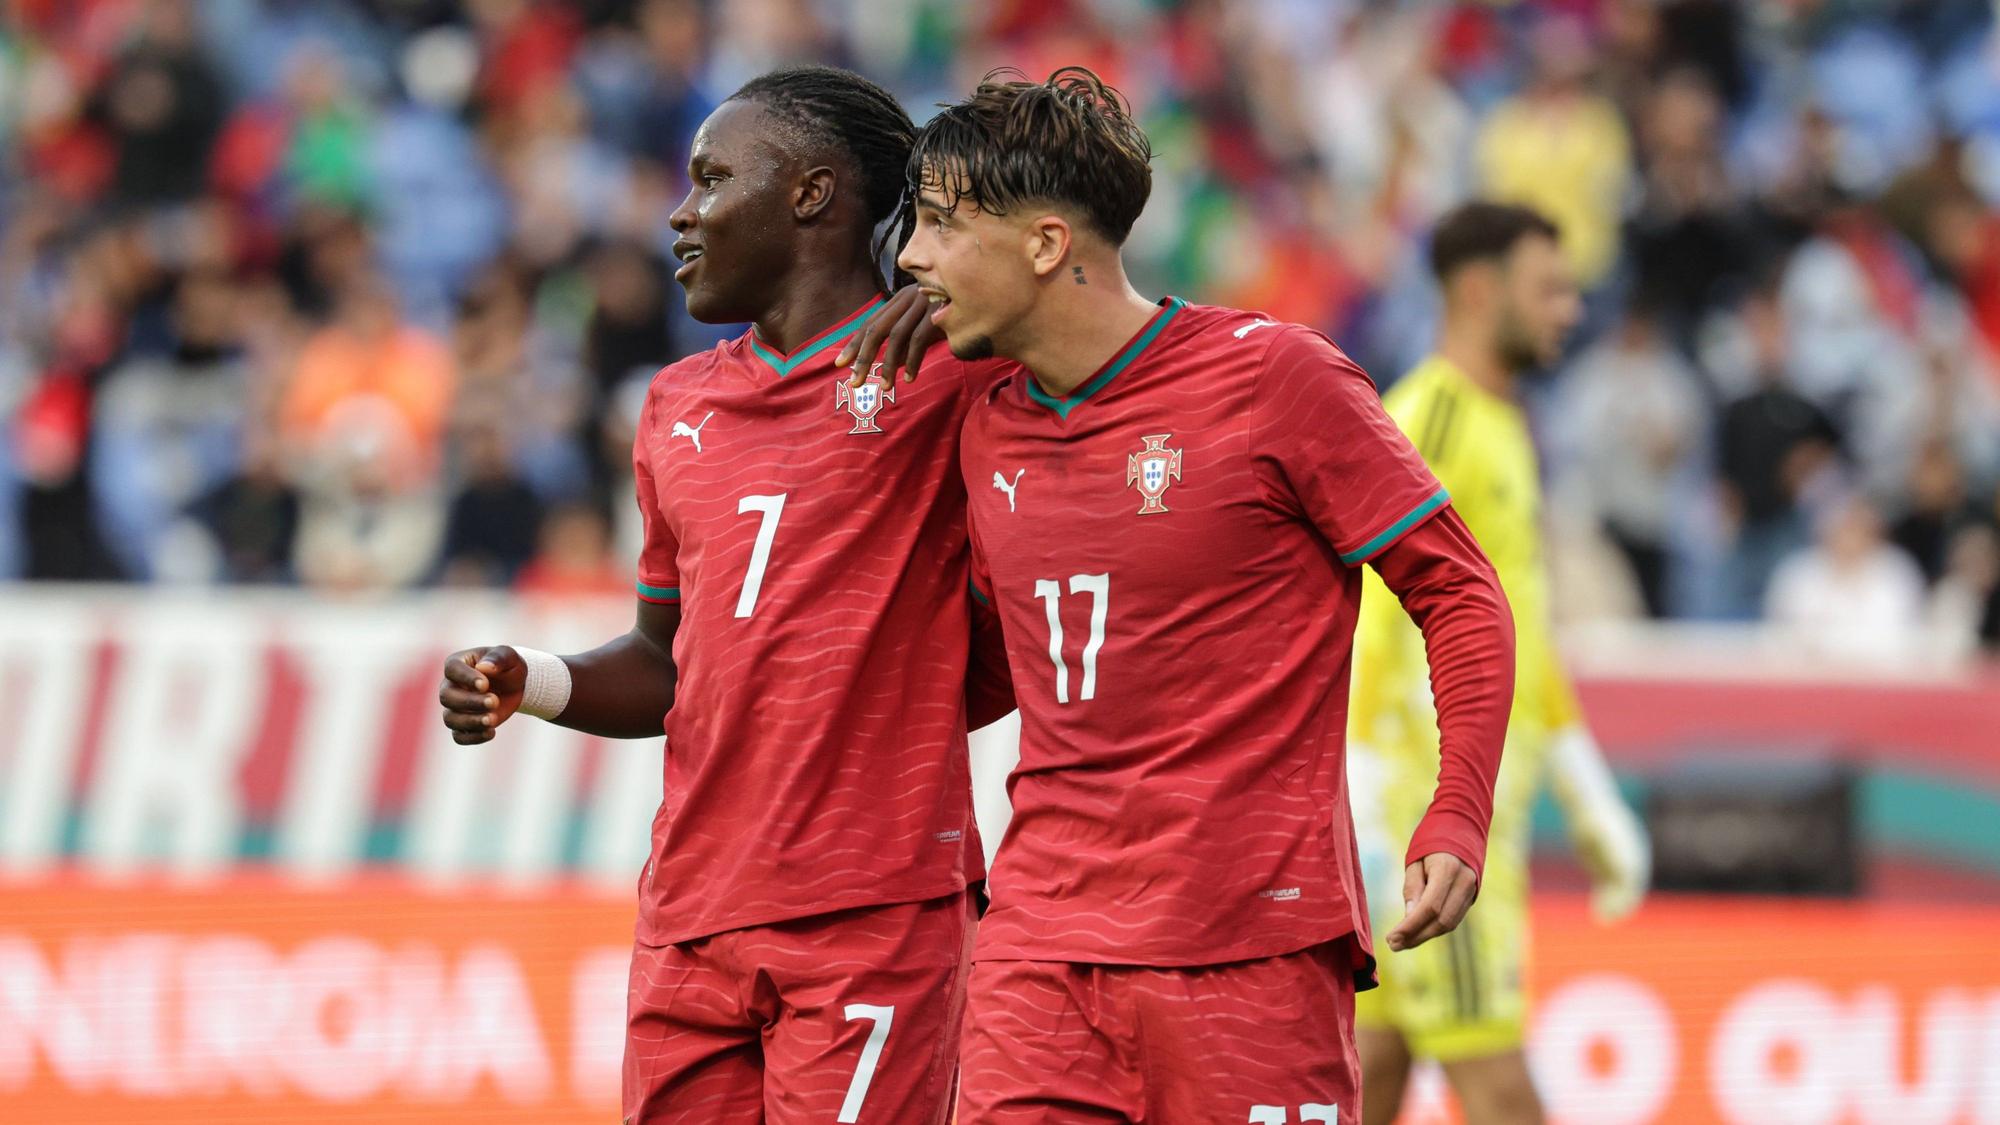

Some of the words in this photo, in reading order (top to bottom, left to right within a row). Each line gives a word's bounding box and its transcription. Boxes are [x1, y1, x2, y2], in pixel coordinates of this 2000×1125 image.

[735, 493, 787, 619] 7
[1035, 573, 1110, 704] 17
[837, 1004, 895, 1124] 7
